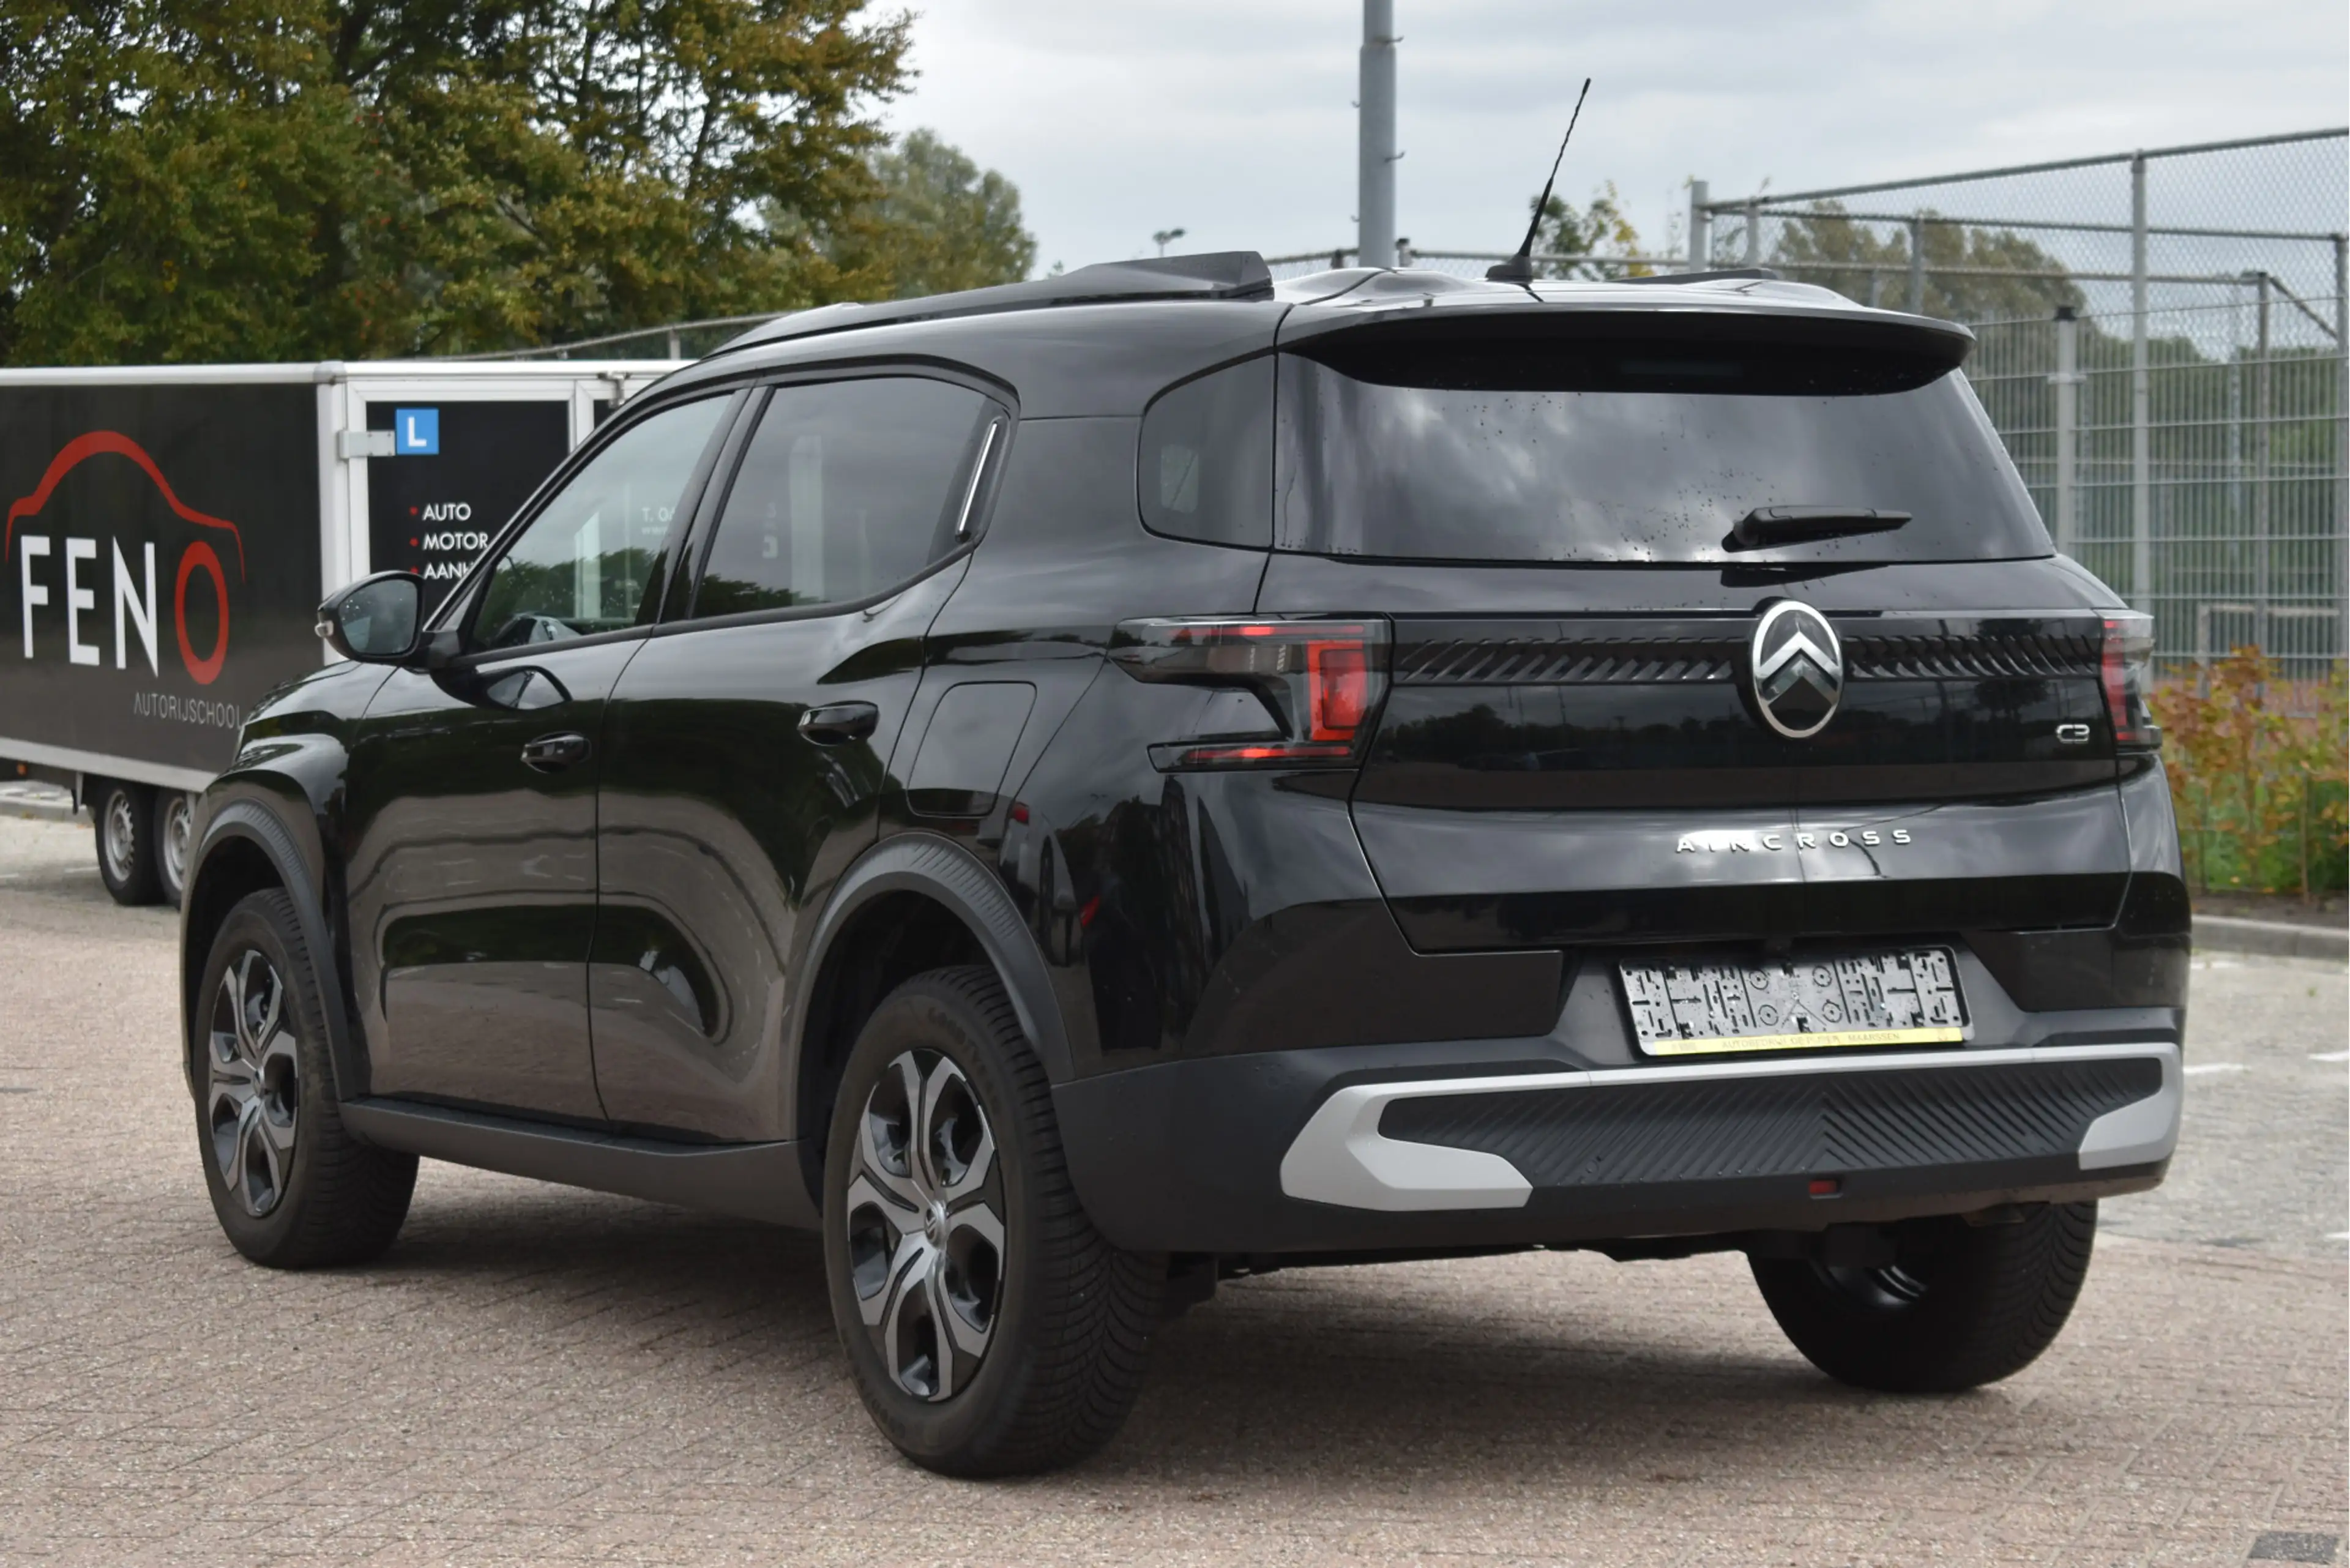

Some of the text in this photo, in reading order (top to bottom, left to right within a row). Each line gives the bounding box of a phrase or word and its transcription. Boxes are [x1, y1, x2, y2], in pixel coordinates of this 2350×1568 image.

[408, 417, 427, 447] L
[422, 502, 472, 521] AUTO
[422, 531, 489, 551] MOTOR
[20, 534, 229, 685] FENO
[133, 691, 243, 730] AUTORIJSCHOOL
[2056, 723, 2091, 744] C3
[1676, 829, 1911, 853] AIRCROSS
